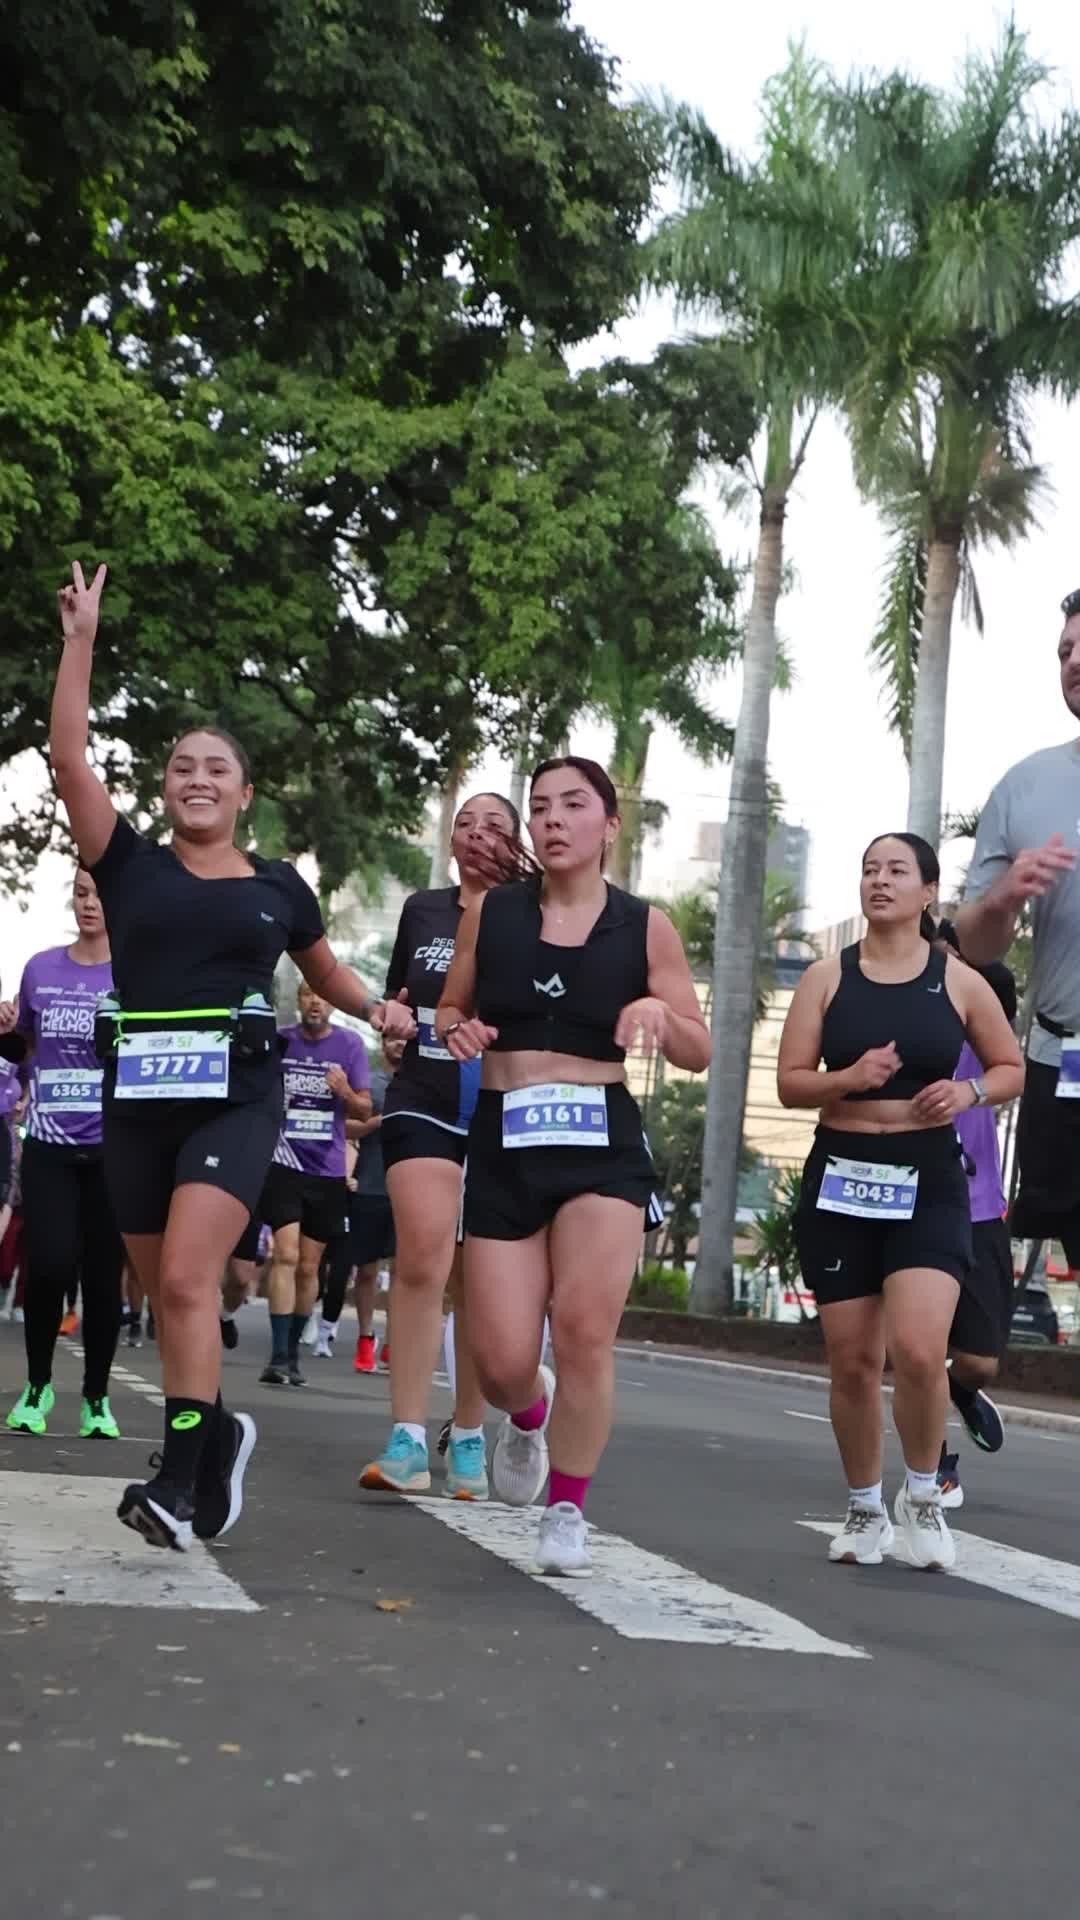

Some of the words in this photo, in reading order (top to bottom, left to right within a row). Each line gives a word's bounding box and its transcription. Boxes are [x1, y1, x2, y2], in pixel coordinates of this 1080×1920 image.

[432, 937, 456, 948] PER
[414, 946, 455, 960] CAR
[425, 959, 451, 972] TE
[140, 1056, 201, 1077] 5777
[51, 1084, 91, 1098] 6365
[525, 1105, 582, 1125] 6161
[842, 1180, 896, 1203] 5043
